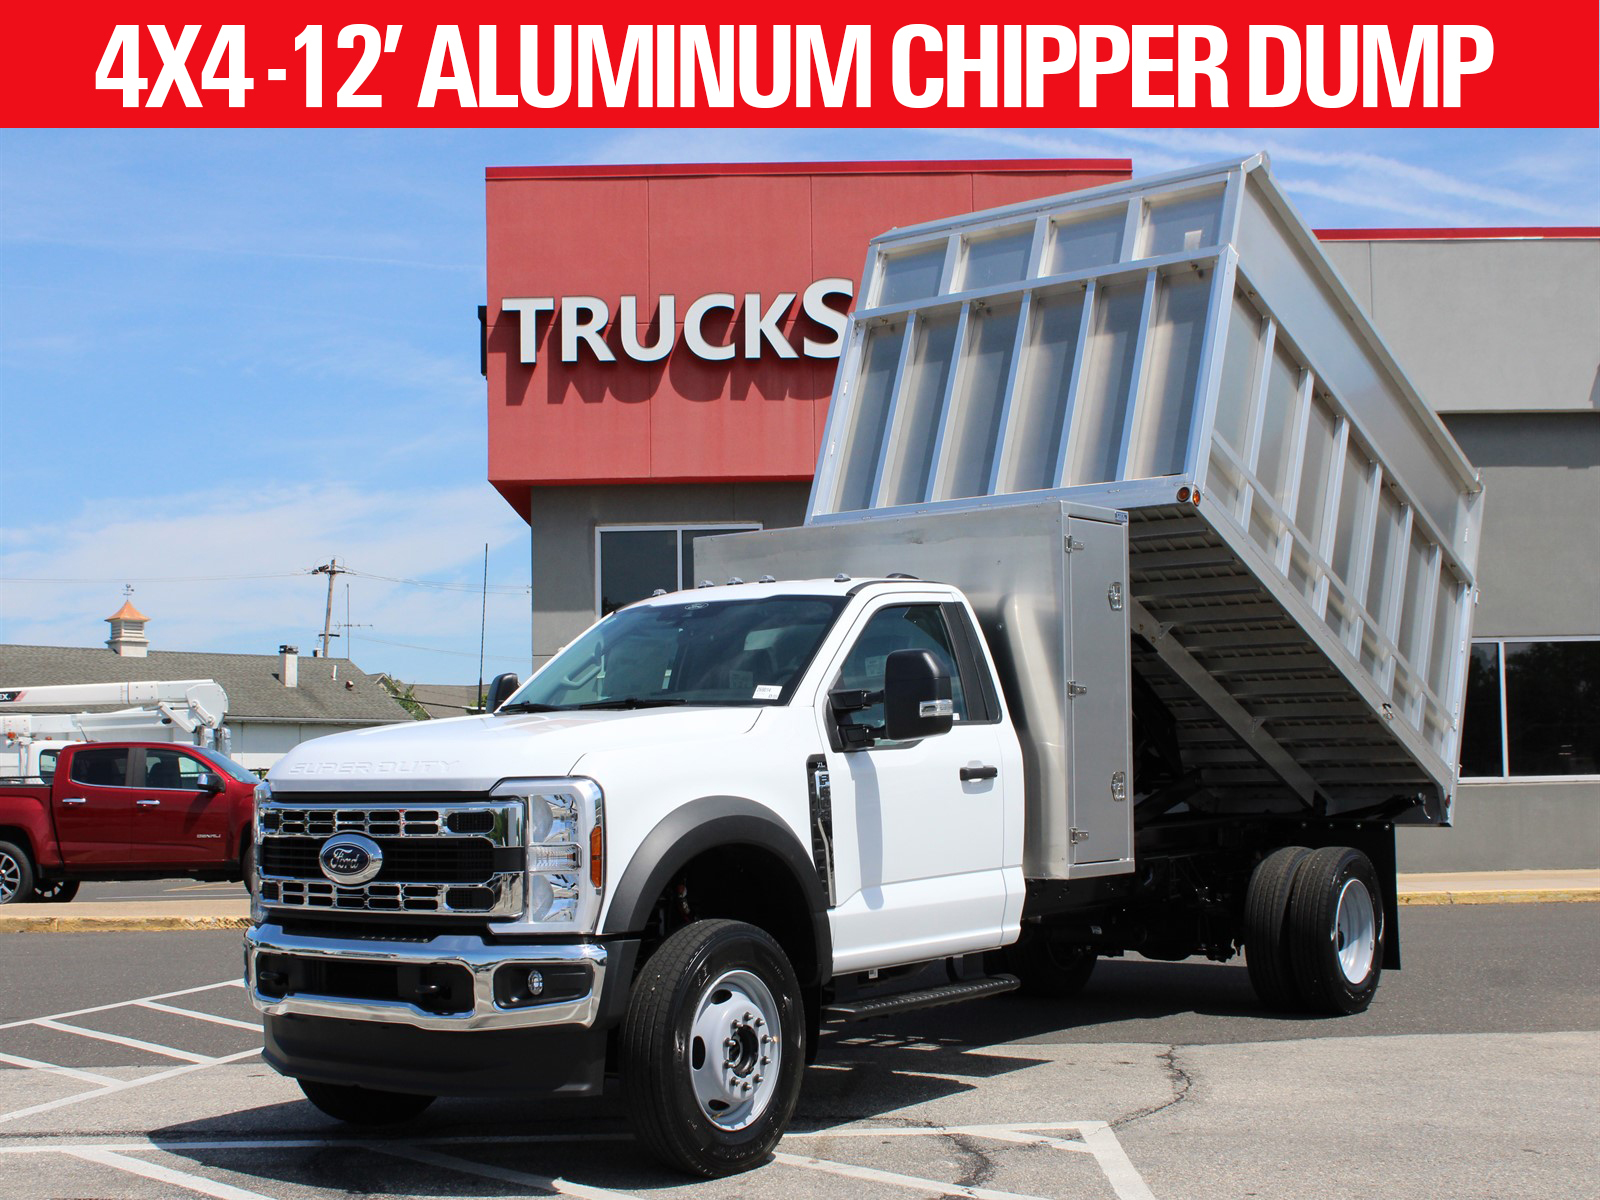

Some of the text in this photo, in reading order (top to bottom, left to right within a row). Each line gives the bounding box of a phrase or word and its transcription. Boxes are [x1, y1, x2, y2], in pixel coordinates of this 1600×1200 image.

[501, 277, 854, 364] TRUCKS
[289, 760, 461, 775] SUPER DUTY
[330, 848, 361, 870] Ford
